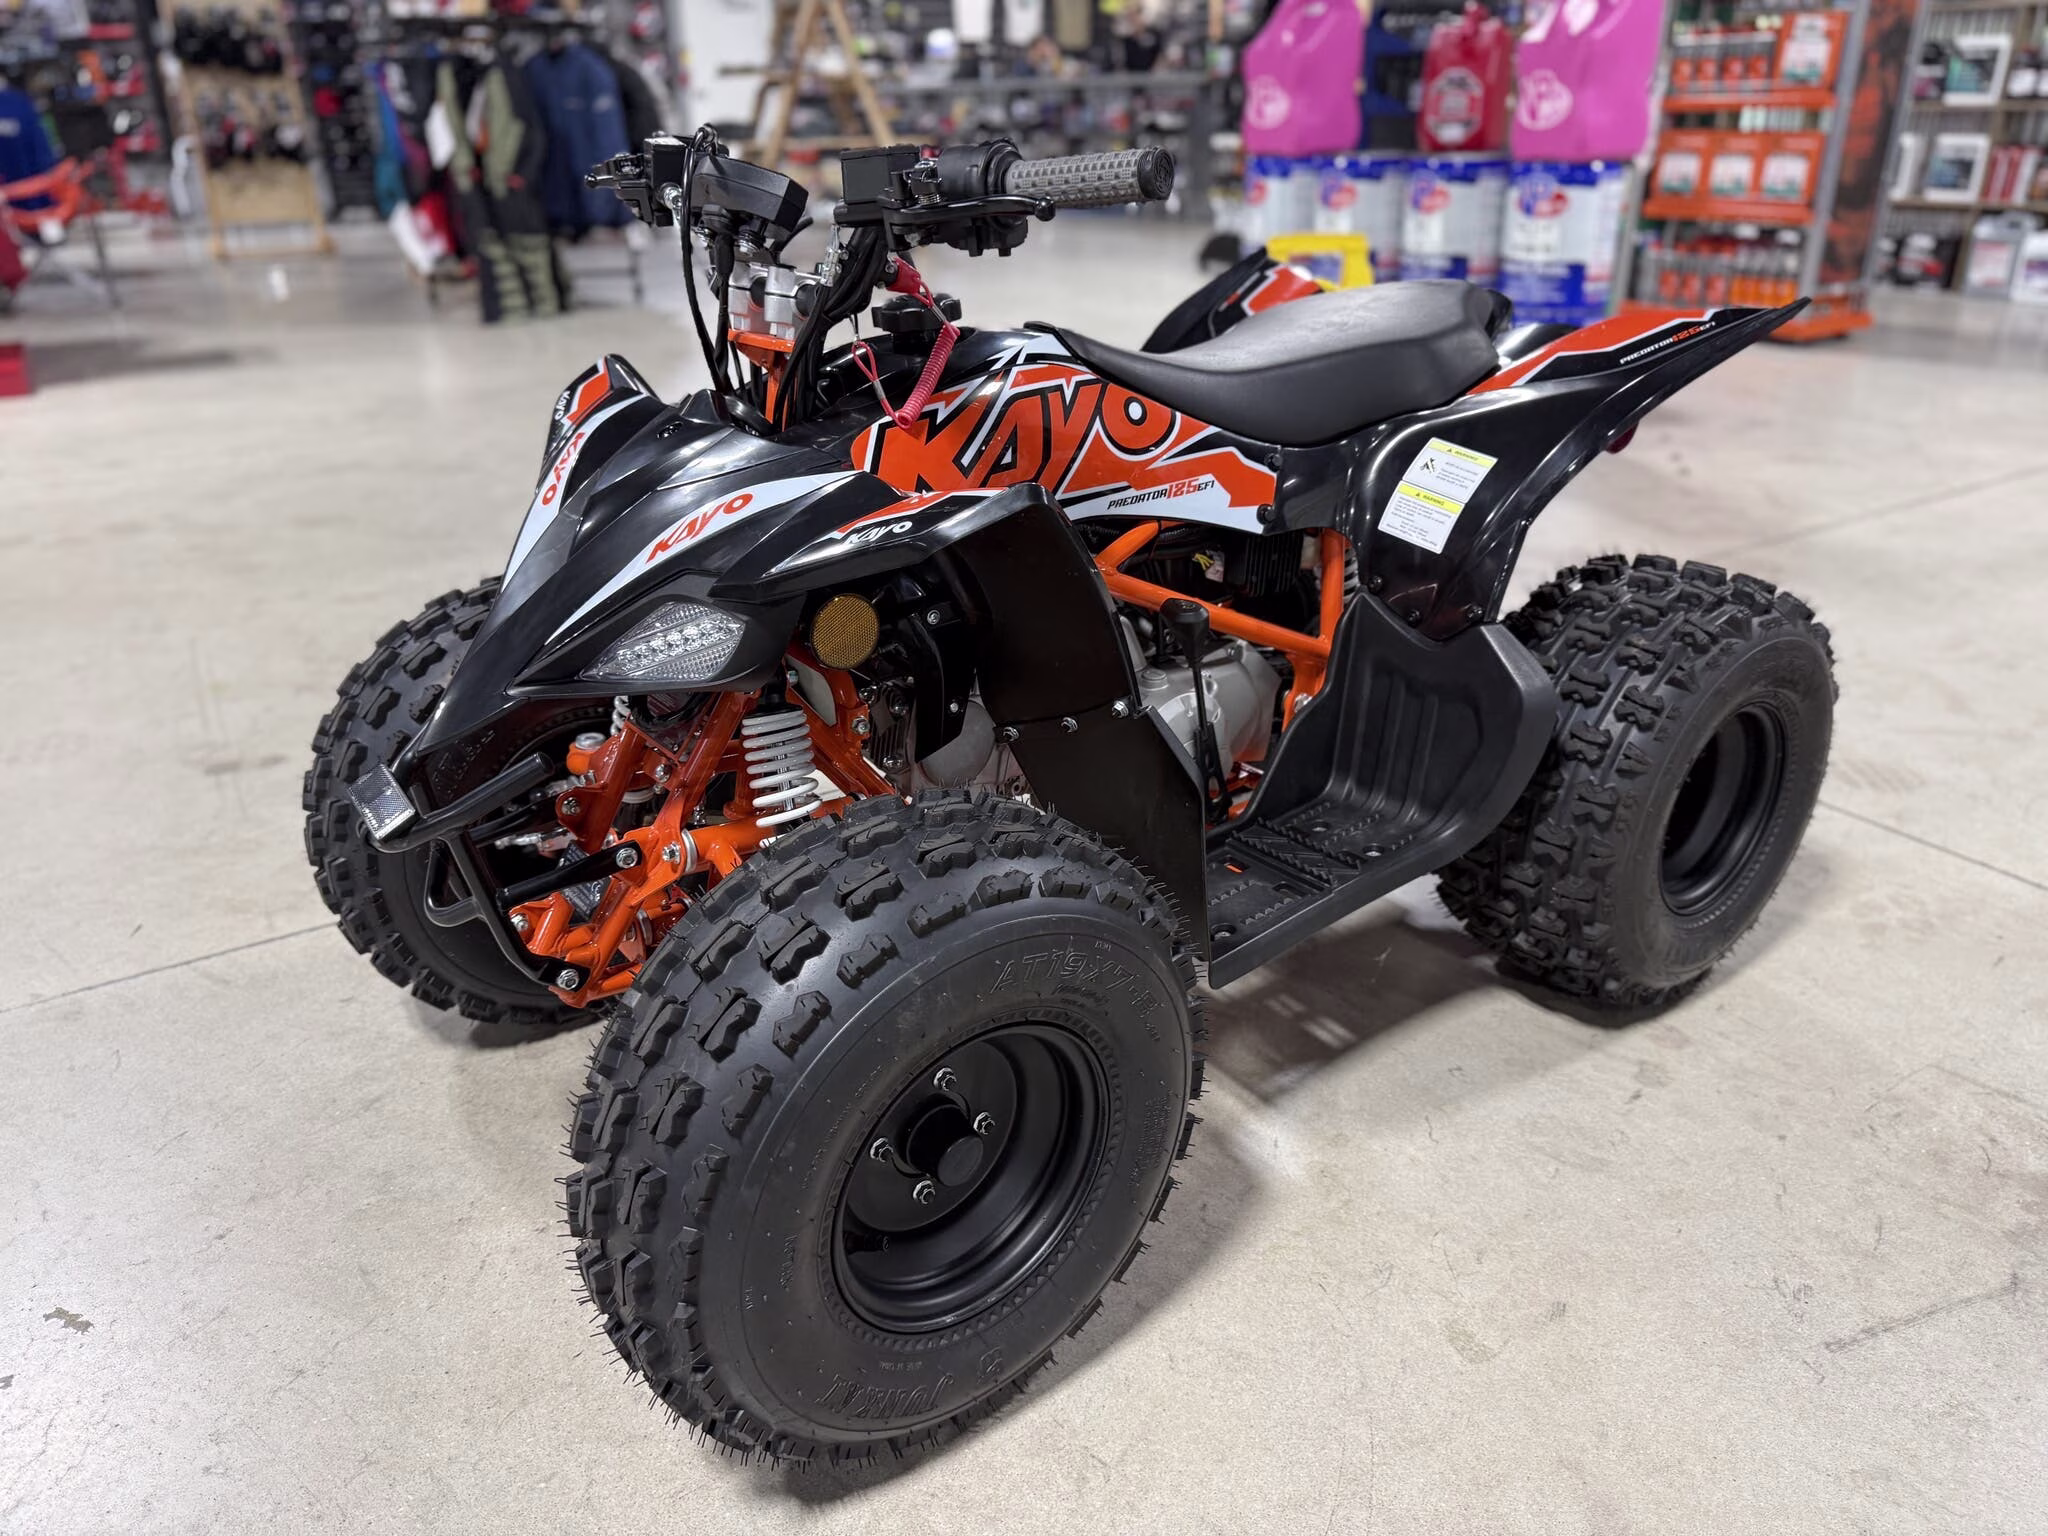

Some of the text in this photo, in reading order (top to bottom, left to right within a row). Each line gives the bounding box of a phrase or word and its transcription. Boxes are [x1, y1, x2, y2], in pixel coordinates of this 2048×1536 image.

[541, 431, 586, 506] KAYO
[870, 371, 1179, 500] KAYO
[644, 492, 754, 565] KAYO
[843, 520, 913, 546] KAYO
